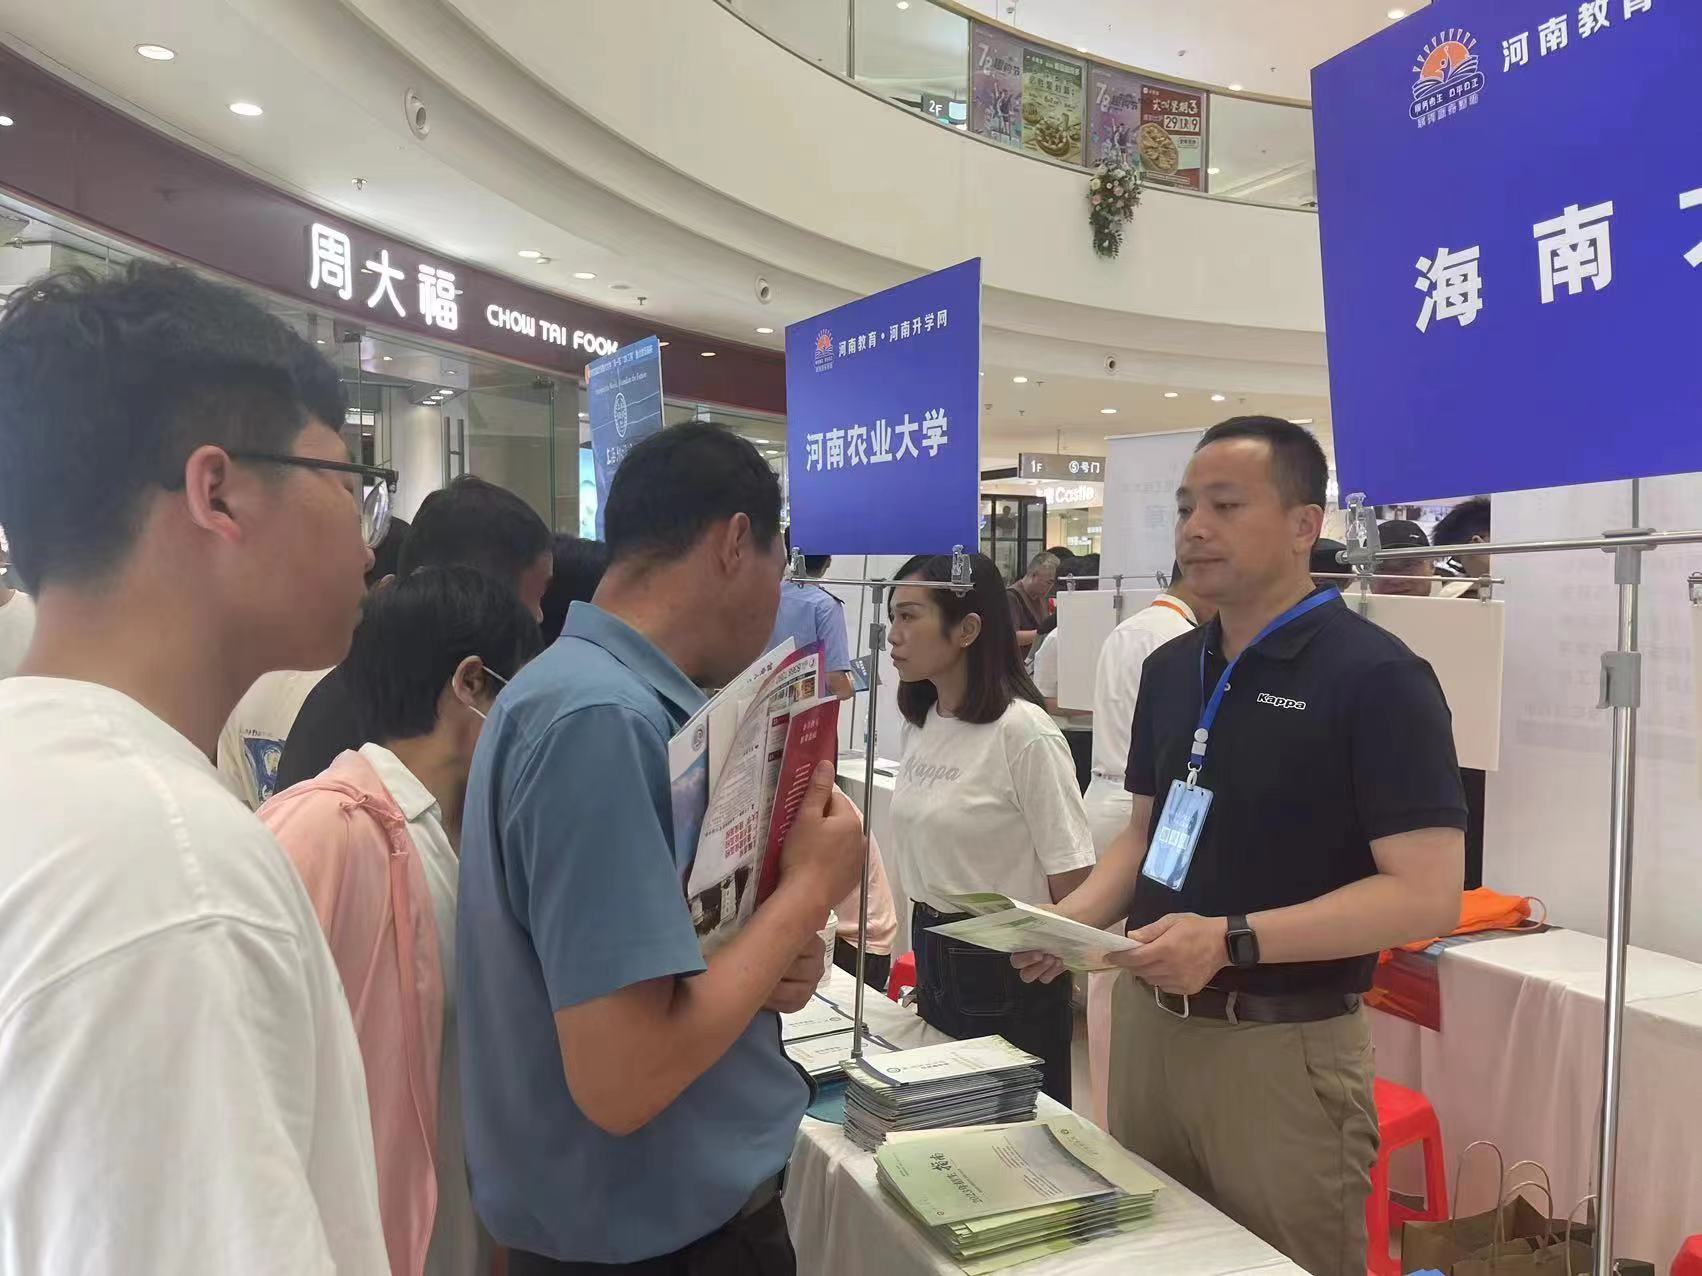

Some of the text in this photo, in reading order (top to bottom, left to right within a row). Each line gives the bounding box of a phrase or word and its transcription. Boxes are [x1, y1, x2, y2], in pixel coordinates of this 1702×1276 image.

[929, 100, 944, 117] 2F
[310, 222, 459, 332] 周大福
[486, 304, 536, 338] CHOW
[539, 319, 567, 346] TAI
[806, 408, 948, 472] 河南农业大学
[1030, 459, 1043, 473] 1F
[1256, 692, 1307, 710] Kappa
[903, 756, 961, 789] Kappa
